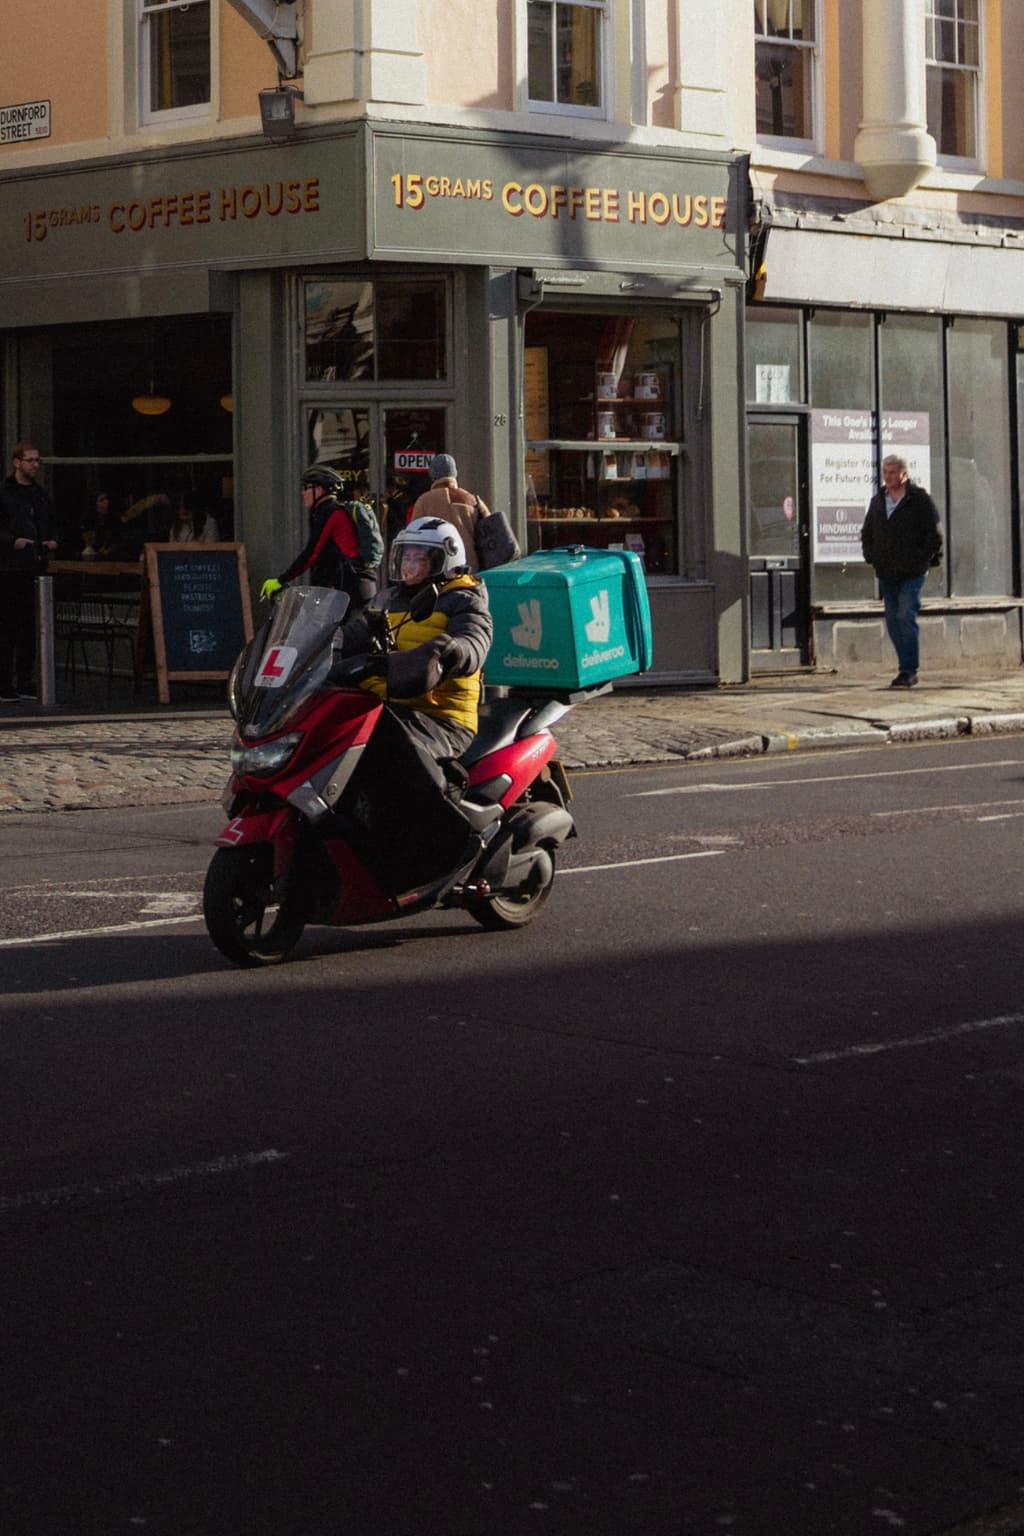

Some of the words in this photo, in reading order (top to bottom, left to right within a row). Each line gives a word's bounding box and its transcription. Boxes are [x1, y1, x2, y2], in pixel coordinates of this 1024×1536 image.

[0, 104, 47, 124] DURNFORD
[0, 122, 32, 140] STREET
[23, 210, 49, 243] 15
[48, 205, 102, 228] GRAMS
[108, 191, 213, 235] COFFEE
[218, 177, 322, 223] HOUSE
[390, 174, 425, 211] 15
[426, 176, 494, 201] GRAMS
[501, 181, 622, 225] COFFEE
[628, 191, 730, 230] HOUSE
[822, 415, 842, 427] This
[888, 417, 918, 431] Longer
[398, 454, 432, 468] OPEN
[820, 473, 833, 483] For
[261, 650, 284, 677] L
[504, 654, 560, 670] deliveroo
[579, 645, 625, 668] deliveroo
